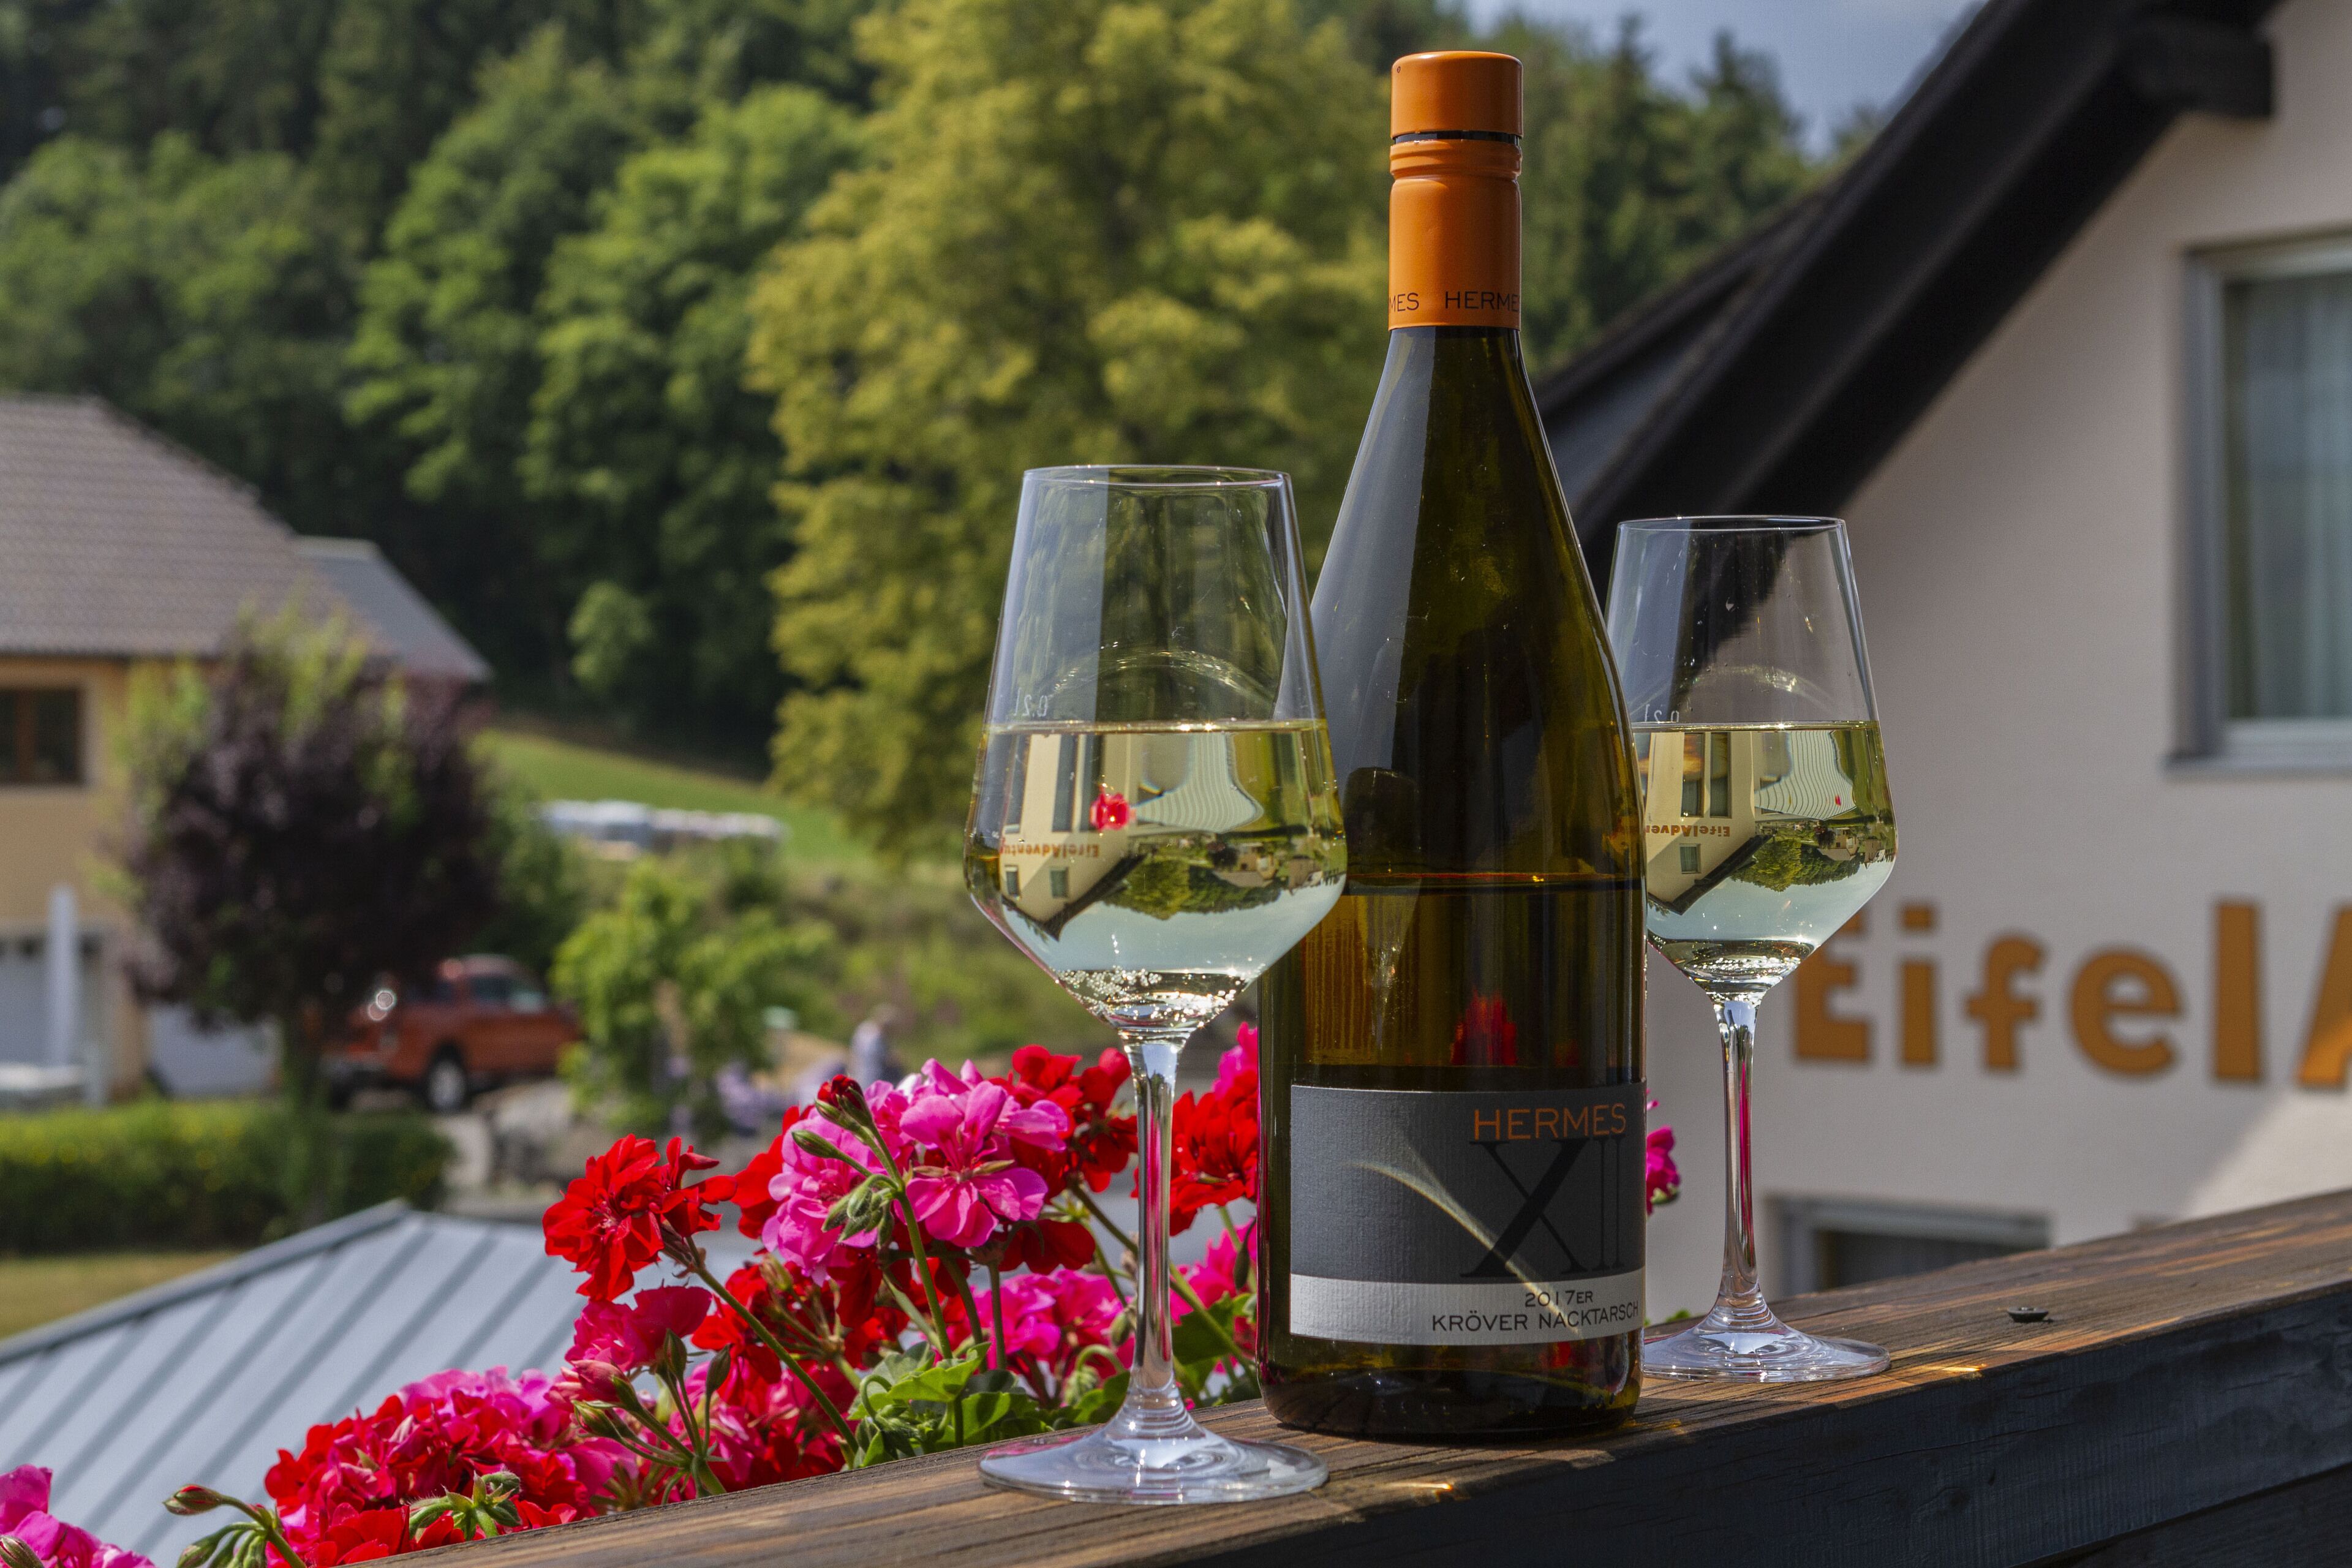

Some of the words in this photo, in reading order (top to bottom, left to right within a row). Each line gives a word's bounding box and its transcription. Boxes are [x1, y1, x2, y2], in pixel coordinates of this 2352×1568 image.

[1446, 290, 1520, 312] HERME
[1474, 1102, 1627, 1141] HERMES
[1459, 1134, 1626, 1278] XII
[1431, 1310, 1528, 1332] KRÖVER
[1539, 1300, 1639, 1330] NACKTARSCH
